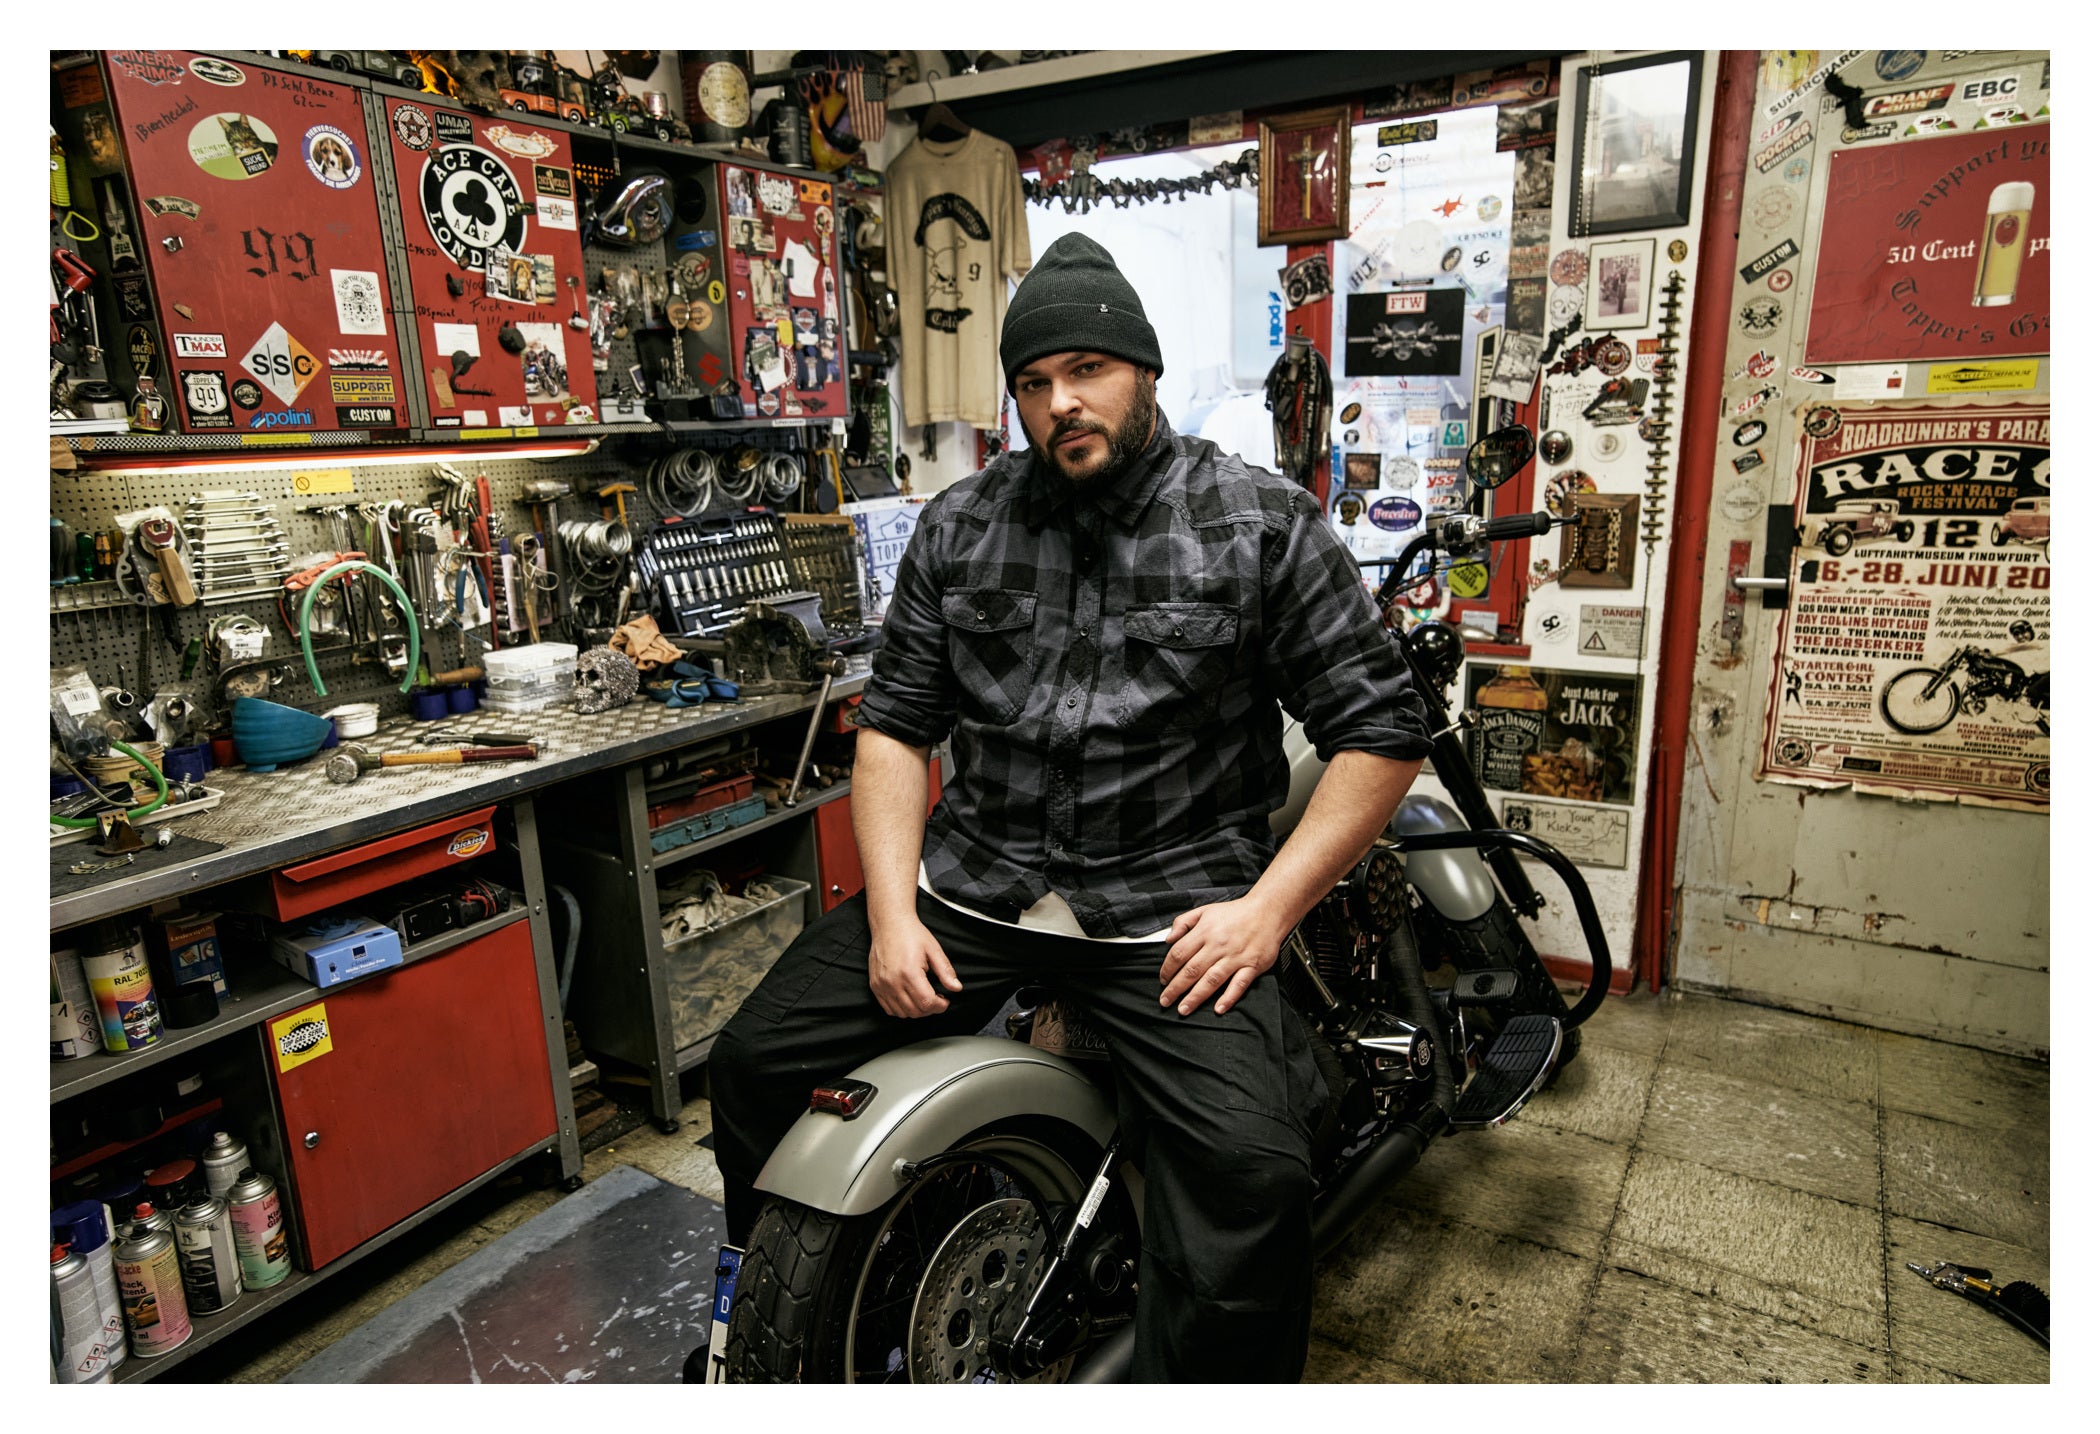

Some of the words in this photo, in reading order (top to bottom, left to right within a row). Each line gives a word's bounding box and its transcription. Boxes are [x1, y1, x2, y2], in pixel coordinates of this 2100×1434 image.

[121, 61, 181, 83] PRIMO
[1963, 78, 2017, 99] EBC
[436, 113, 471, 128] UMAP
[244, 153, 263, 166] SUCHE
[432, 151, 471, 183] ACE
[481, 158, 517, 217] CAFE
[1894, 139, 2009, 238] Support
[454, 218, 489, 242] ACE
[429, 211, 513, 268] LONDN
[240, 227, 320, 282] 99
[1752, 243, 1793, 273] CUSTOM
[1887, 246, 1916, 264] 50
[1921, 239, 1977, 262] Cent
[969, 262, 981, 281] 9
[1390, 296, 1422, 309] FTW
[1891, 276, 1995, 344] Topper's
[1268, 305, 1283, 347] polini
[191, 342, 224, 352] MAX
[1791, 366, 1819, 379] SIP
[196, 387, 218, 409] 99
[1737, 394, 1761, 416] SIP
[265, 408, 312, 429] polini
[350, 409, 392, 421] CUSTOM
[1841, 420, 1991, 454] ROADRUNNER'S
[1817, 449, 2021, 498] RACE
[1897, 484, 2019, 498] ROCK'N'RACE
[1911, 497, 1999, 510] FESTIVAL
[895, 519, 909, 535] 99
[1921, 518, 1982, 548] 12
[1854, 549, 1965, 561] LUFTFAHRTMUSEUM
[1969, 550, 2040, 563] FINOWFURT
[1821, 560, 1911, 585] 6.-28.
[1917, 562, 1998, 588] JUNI
[1798, 603, 1815, 613] LOS
[1817, 604, 1838, 614] RAW
[1840, 605, 1867, 615] MEAT
[1872, 607, 1893, 617] CRY
[1893, 608, 1930, 618] BABIES
[1860, 597, 1872, 606] HIS
[1874, 598, 1899, 607] LITTLE
[1602, 608, 1642, 618] DANGER
[1796, 614, 1818, 625] RAY
[1820, 615, 1869, 627] COLLINS
[1871, 617, 1895, 629] HOT
[1896, 619, 1929, 631] CLUB
[1795, 625, 1840, 636] BOOZED
[1848, 628, 1870, 637] THE
[1872, 629, 1926, 641] NOMADS
[1794, 635, 1821, 647] THE
[1824, 636, 1925, 653] BERSERKERZ
[1793, 646, 1860, 658] TEENAGE
[1862, 649, 1924, 662] TERROR
[1804, 671, 1875, 684] CONTEST
[1561, 686, 1582, 699] Just
[1584, 687, 1600, 701] Ask
[1602, 688, 1619, 702] For
[1845, 684, 1873, 693] MAI
[1841, 700, 1871, 709] JUNI
[1560, 699, 1615, 728] JACK
[1483, 715, 1506, 732] JACK
[1506, 712, 1541, 736] DANIEL'S
[1510, 820, 1526, 830] 66
[453, 835, 487, 851] Dickies
[114, 975, 133, 986] RAL
[295, 1033, 307, 1044] GAS
[720, 1295, 730, 1314] D
